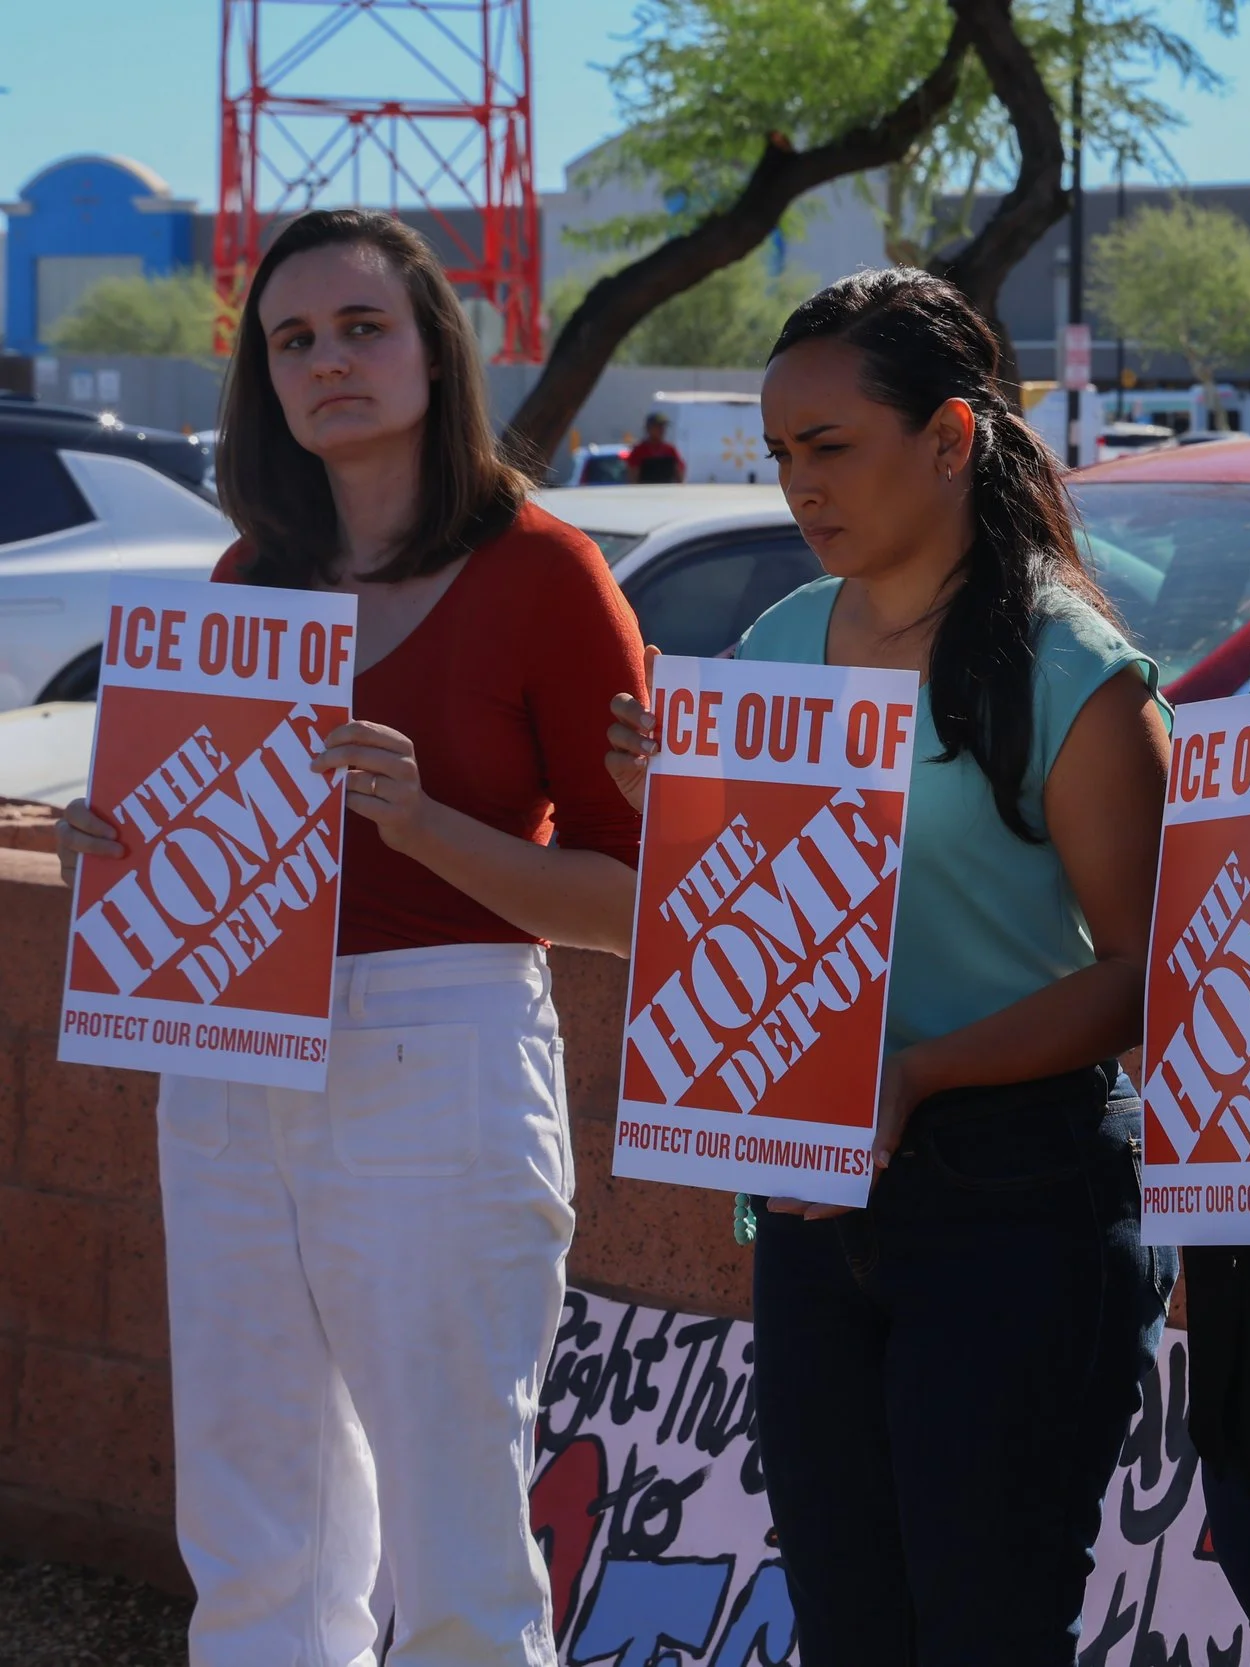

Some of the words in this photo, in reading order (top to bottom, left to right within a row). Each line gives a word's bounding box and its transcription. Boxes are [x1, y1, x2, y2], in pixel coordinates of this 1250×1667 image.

[106, 605, 186, 671] ICE
[199, 612, 288, 680] OUT
[300, 621, 353, 685] OF
[112, 724, 231, 844] THE
[654, 688, 723, 757] ICE
[735, 692, 834, 764] OUT
[845, 700, 913, 770] OF
[1167, 730, 1226, 804] ICE
[74, 701, 347, 996] HOME
[658, 812, 767, 942] THE
[176, 819, 339, 1004] DEPOT
[626, 786, 900, 1106] HOME
[64, 1010, 149, 1042] PROTECT
[152, 1019, 190, 1047] OUR
[195, 1023, 327, 1063] COMMUNITIES!
[716, 912, 888, 1114] DEPOT
[618, 1121, 692, 1155] PROTECT
[696, 1130, 731, 1159] OUR
[734, 1135, 872, 1176] COMMUNITIES!
[1143, 1185, 1202, 1214] PROTECT
[1205, 1185, 1234, 1213] OUR
[656, 1318, 766, 1493] Thi
[587, 1443, 712, 1557] to
